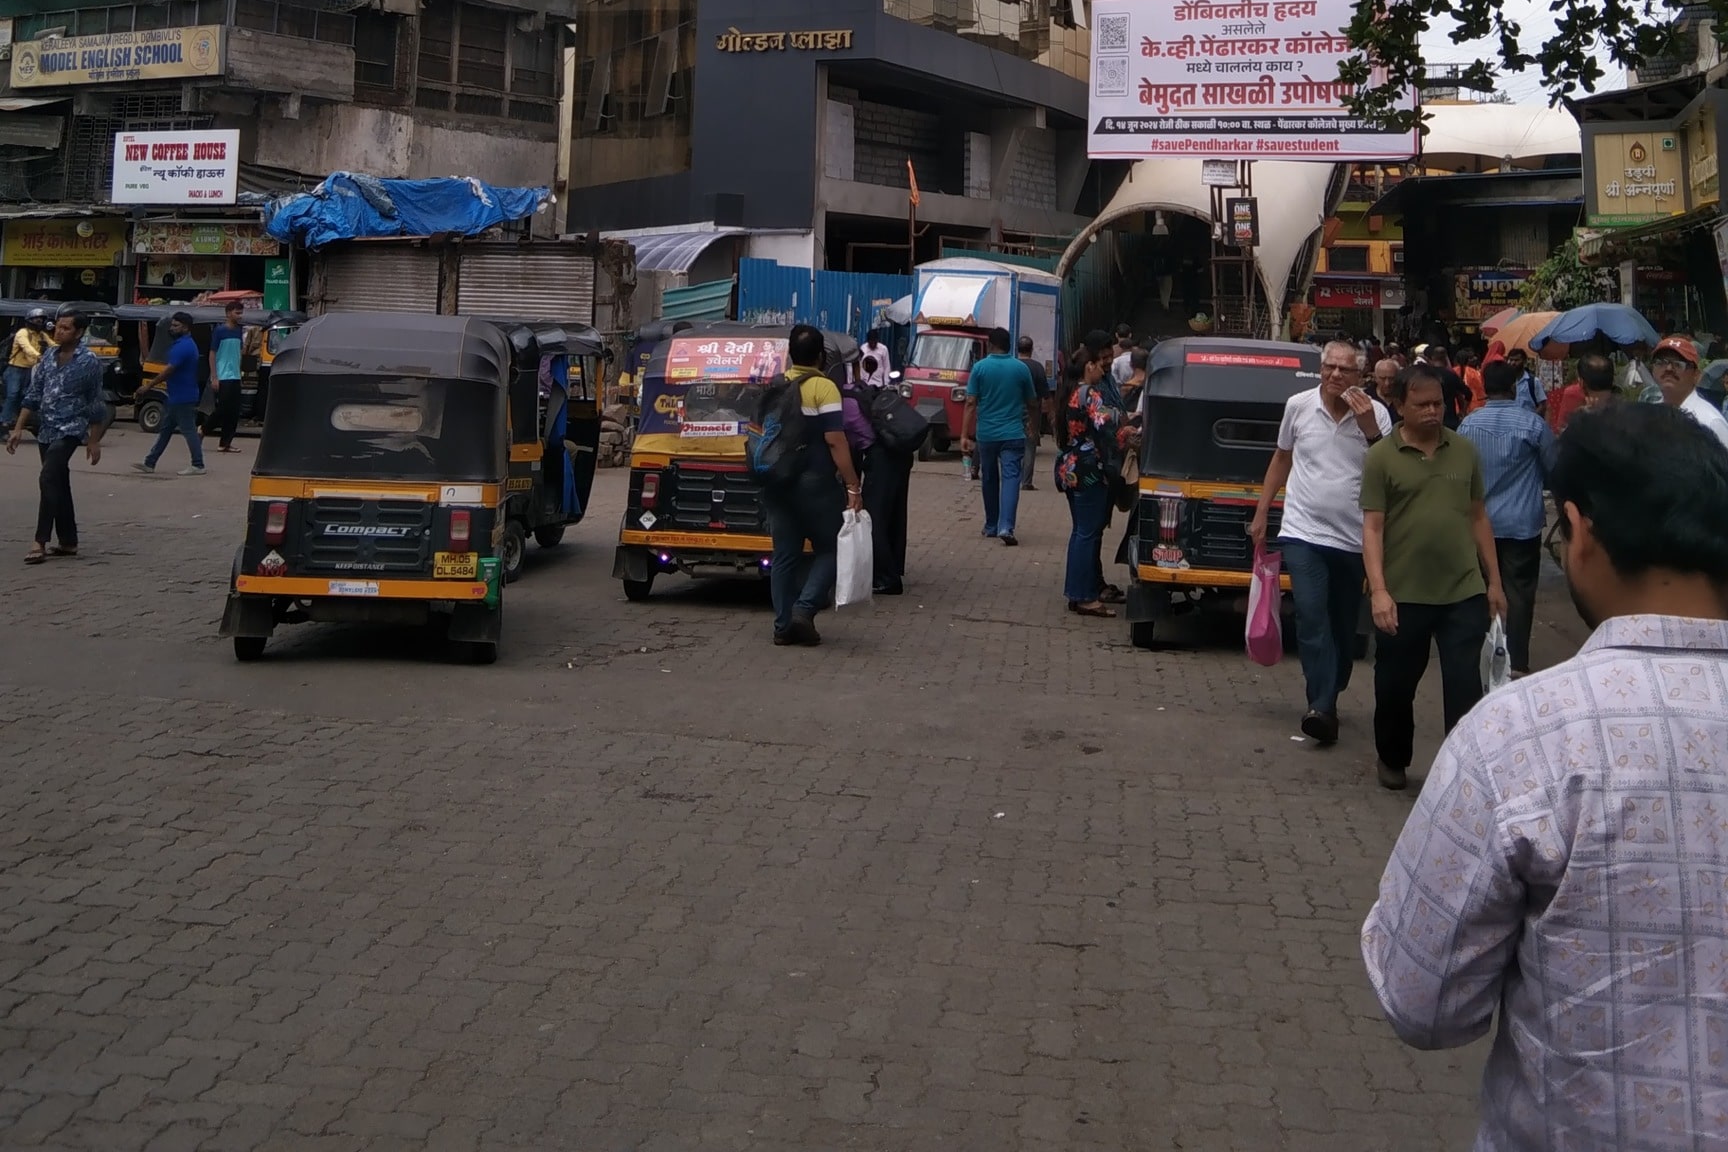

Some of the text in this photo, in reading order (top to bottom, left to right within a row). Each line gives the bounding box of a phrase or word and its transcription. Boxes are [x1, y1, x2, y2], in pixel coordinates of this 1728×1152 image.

[1273, 0, 1318, 22] हृदय
[1221, 20, 1266, 36] असलेले
[715, 25, 853, 53] गोल्डन प्लाझा
[40, 42, 184, 73] MODEL ENGLISH SCHOOL
[1186, 59, 1212, 74] मध्ये
[1265, 60, 1294, 73] काय
[1138, 77, 1198, 115] बेमुदत
[1201, 74, 1276, 105] साखळी
[1127, 120, 1139, 133] जून
[1159, 118, 1174, 130] रोजी
[1175, 118, 1190, 129] ठीक
[1191, 118, 1216, 129] सकाळी
[125, 142, 226, 161] NEW COFFEE HOUSE
[1151, 138, 1340, 152] #savePendharkar #savestudent
[153, 168, 168, 181] न्यू
[168, 165, 195, 178] कॉफी
[196, 168, 226, 179] हाऊस
[1605, 179, 1676, 202] श्री अन्नपूर्णा
[1234, 204, 1250, 213] ONE
[1235, 222, 1251, 231] ONE
[697, 341, 755, 354] श्री देवी
[1152, 548, 1183, 562] STOP
[353, 563, 385, 571] DISTANCE
